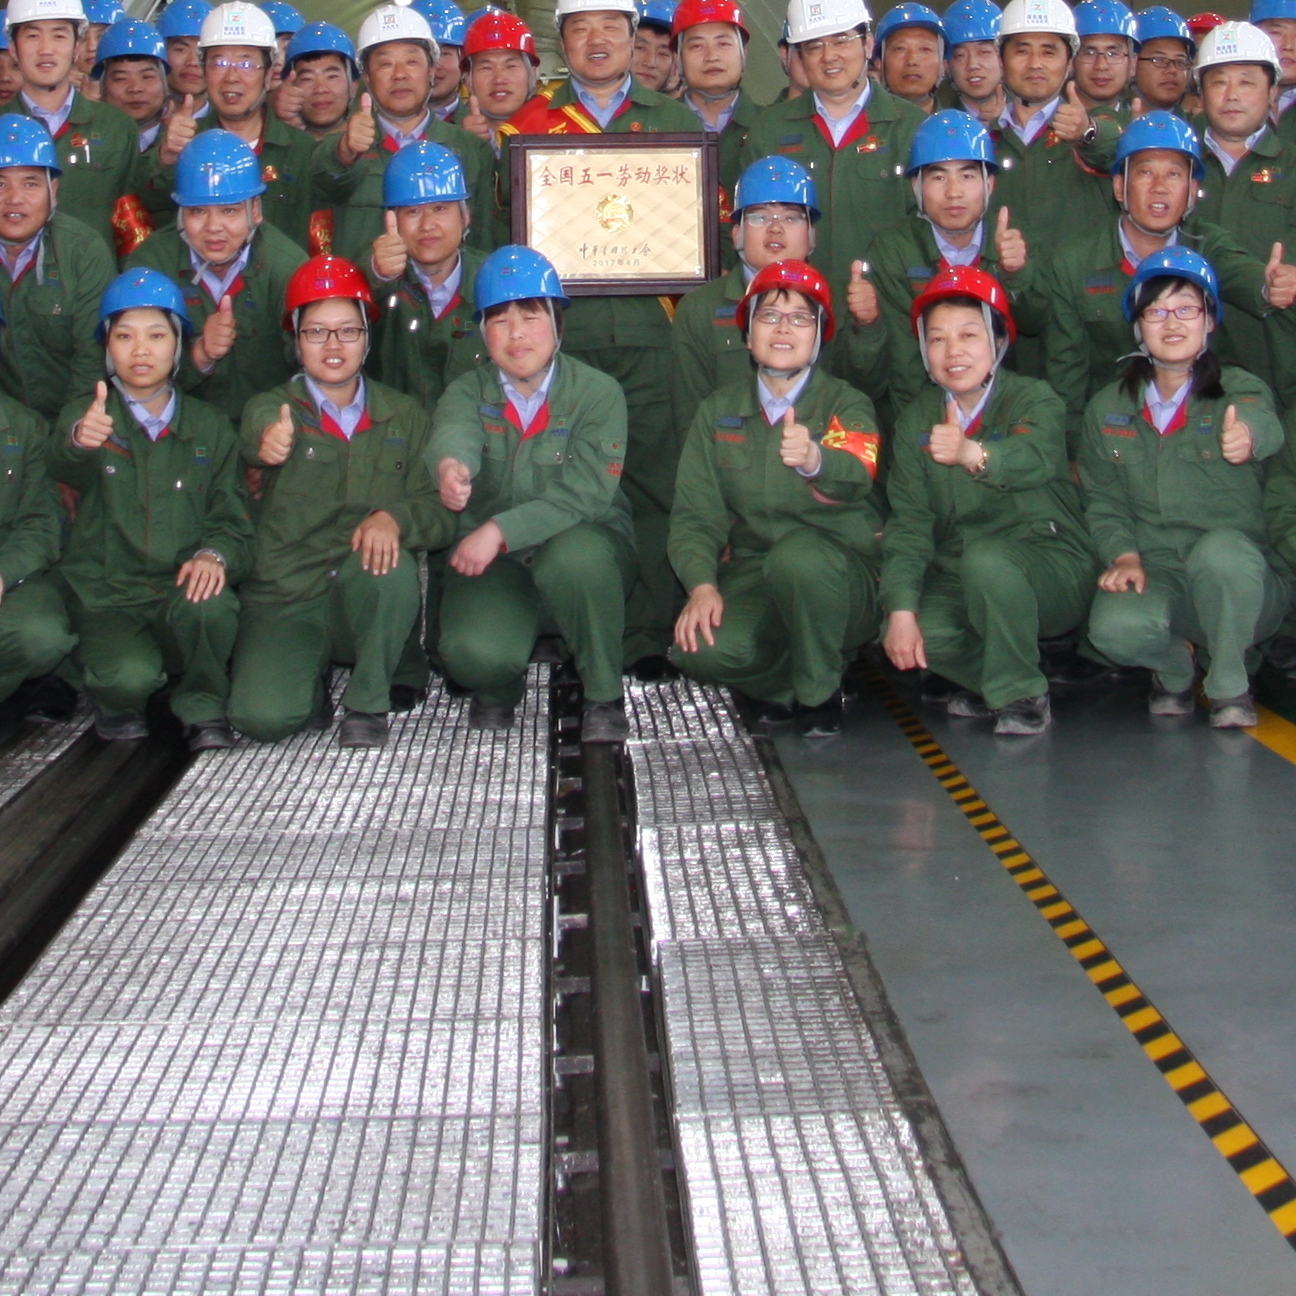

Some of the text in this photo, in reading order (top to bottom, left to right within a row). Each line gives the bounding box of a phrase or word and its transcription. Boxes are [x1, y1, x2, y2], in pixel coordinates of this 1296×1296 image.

[538, 163, 692, 188] 全国五一劳动奖状
[592, 258, 640, 267] 2017年4月
